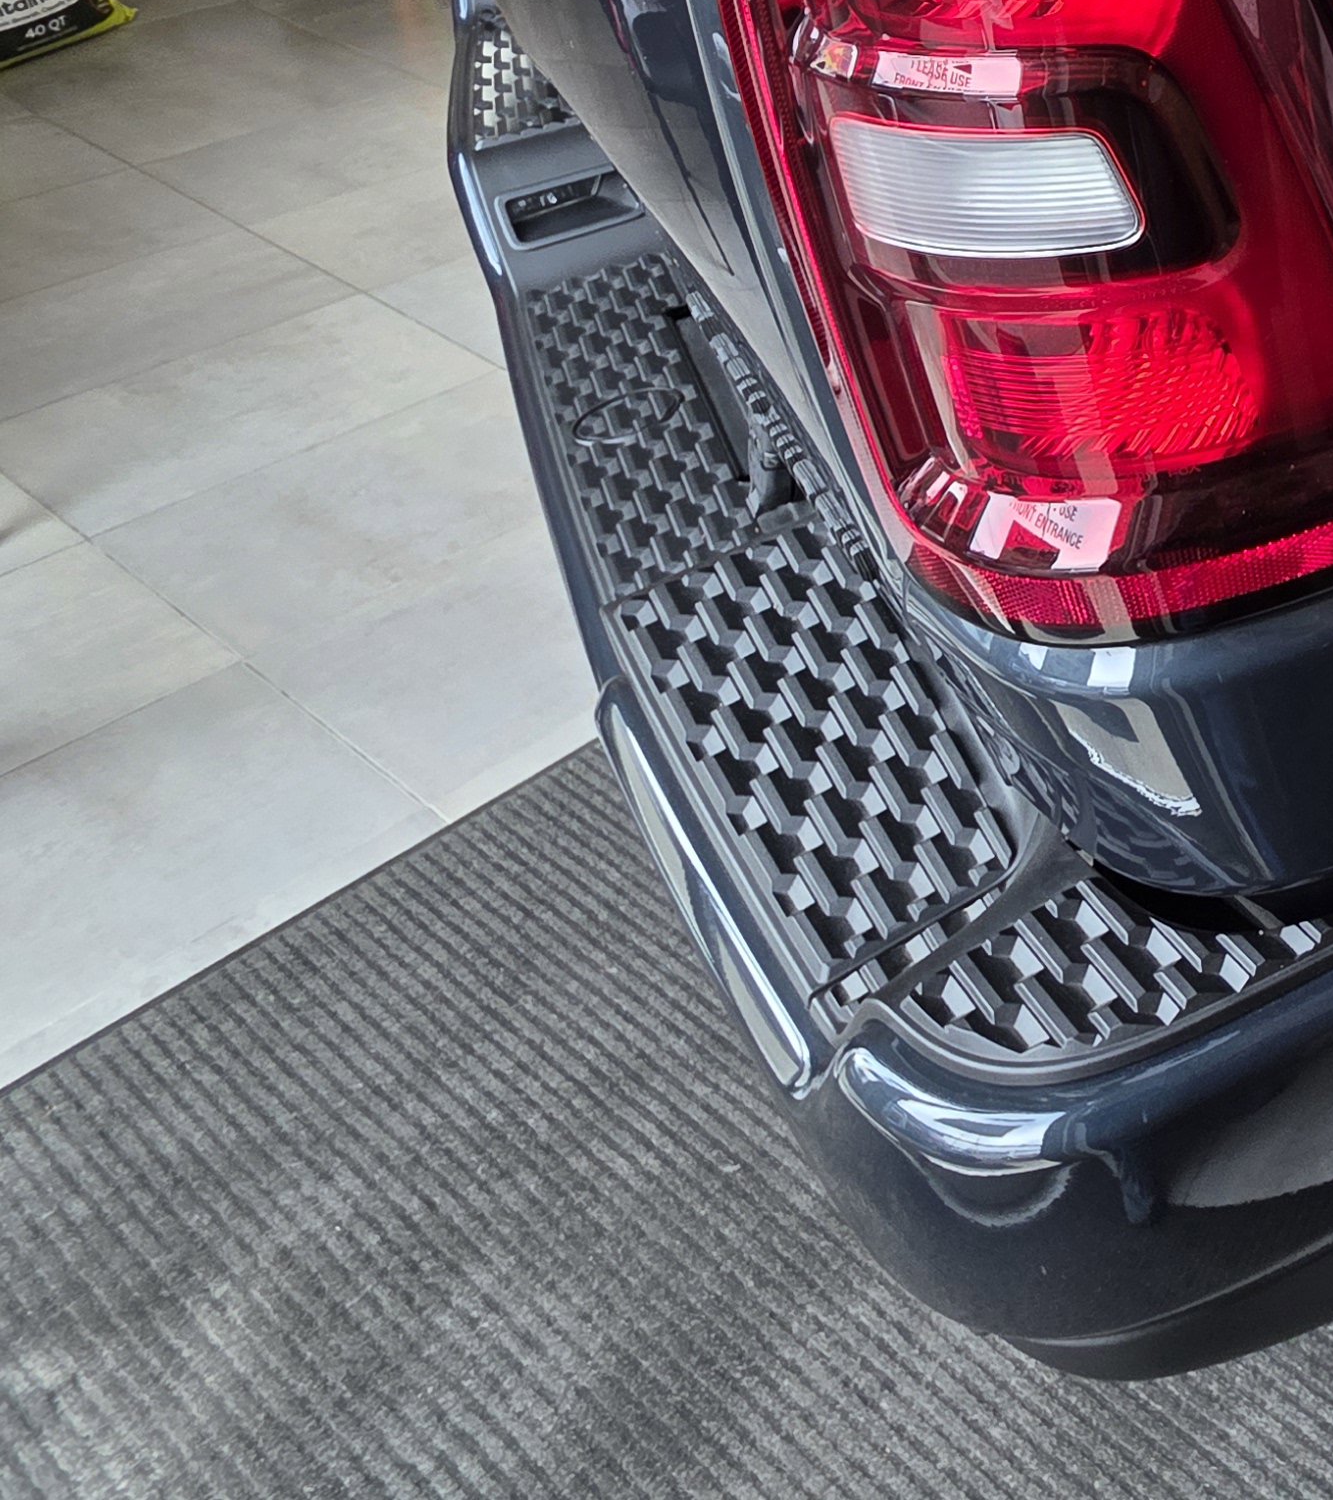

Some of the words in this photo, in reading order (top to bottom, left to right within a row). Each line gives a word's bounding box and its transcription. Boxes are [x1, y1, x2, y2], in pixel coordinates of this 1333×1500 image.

[25, 24, 46, 38] 40
[48, 15, 67, 32] QT
[950, 71, 972, 88] USE
[1034, 513, 1084, 550] ENTRANCE
